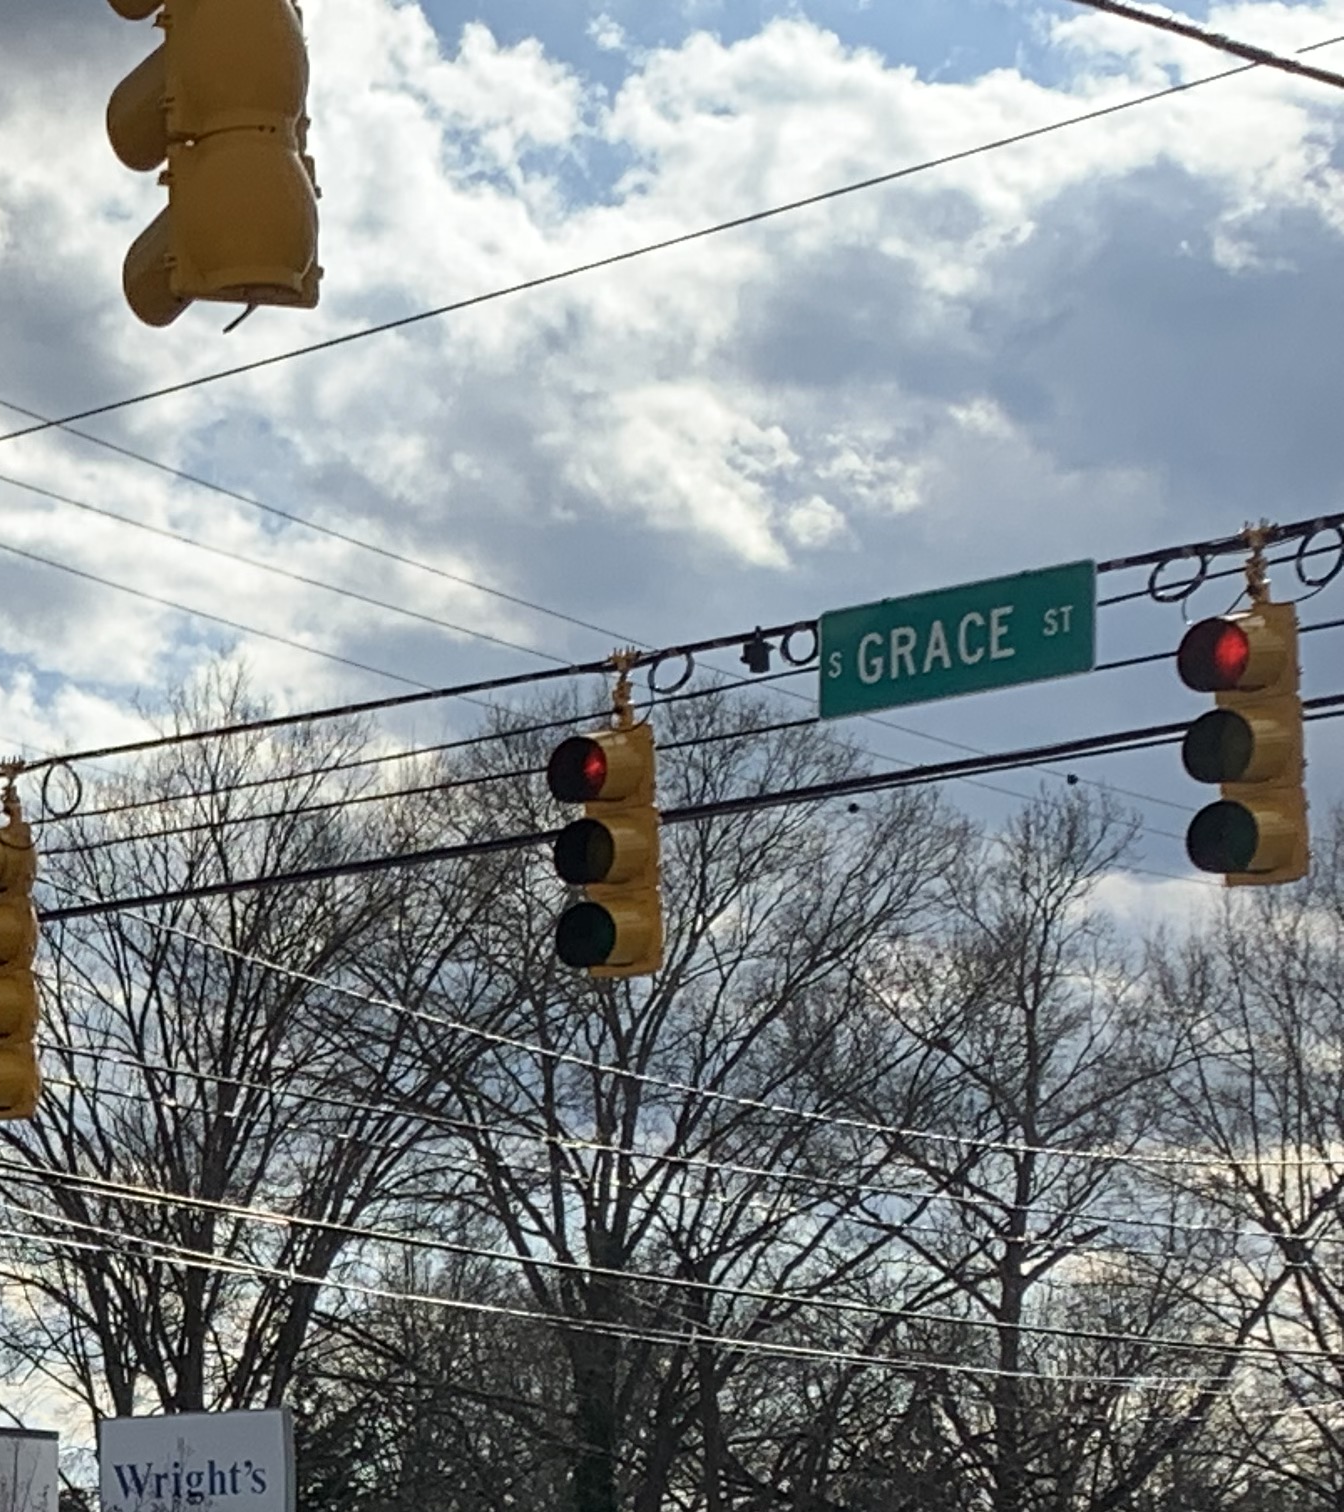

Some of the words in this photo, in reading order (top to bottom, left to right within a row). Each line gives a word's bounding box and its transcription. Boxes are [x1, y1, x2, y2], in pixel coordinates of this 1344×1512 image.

[828, 651, 843, 679] S
[857, 605, 1016, 685] GRACE
[1043, 605, 1075, 637] ST
[113, 1459, 268, 1506] Wright's
